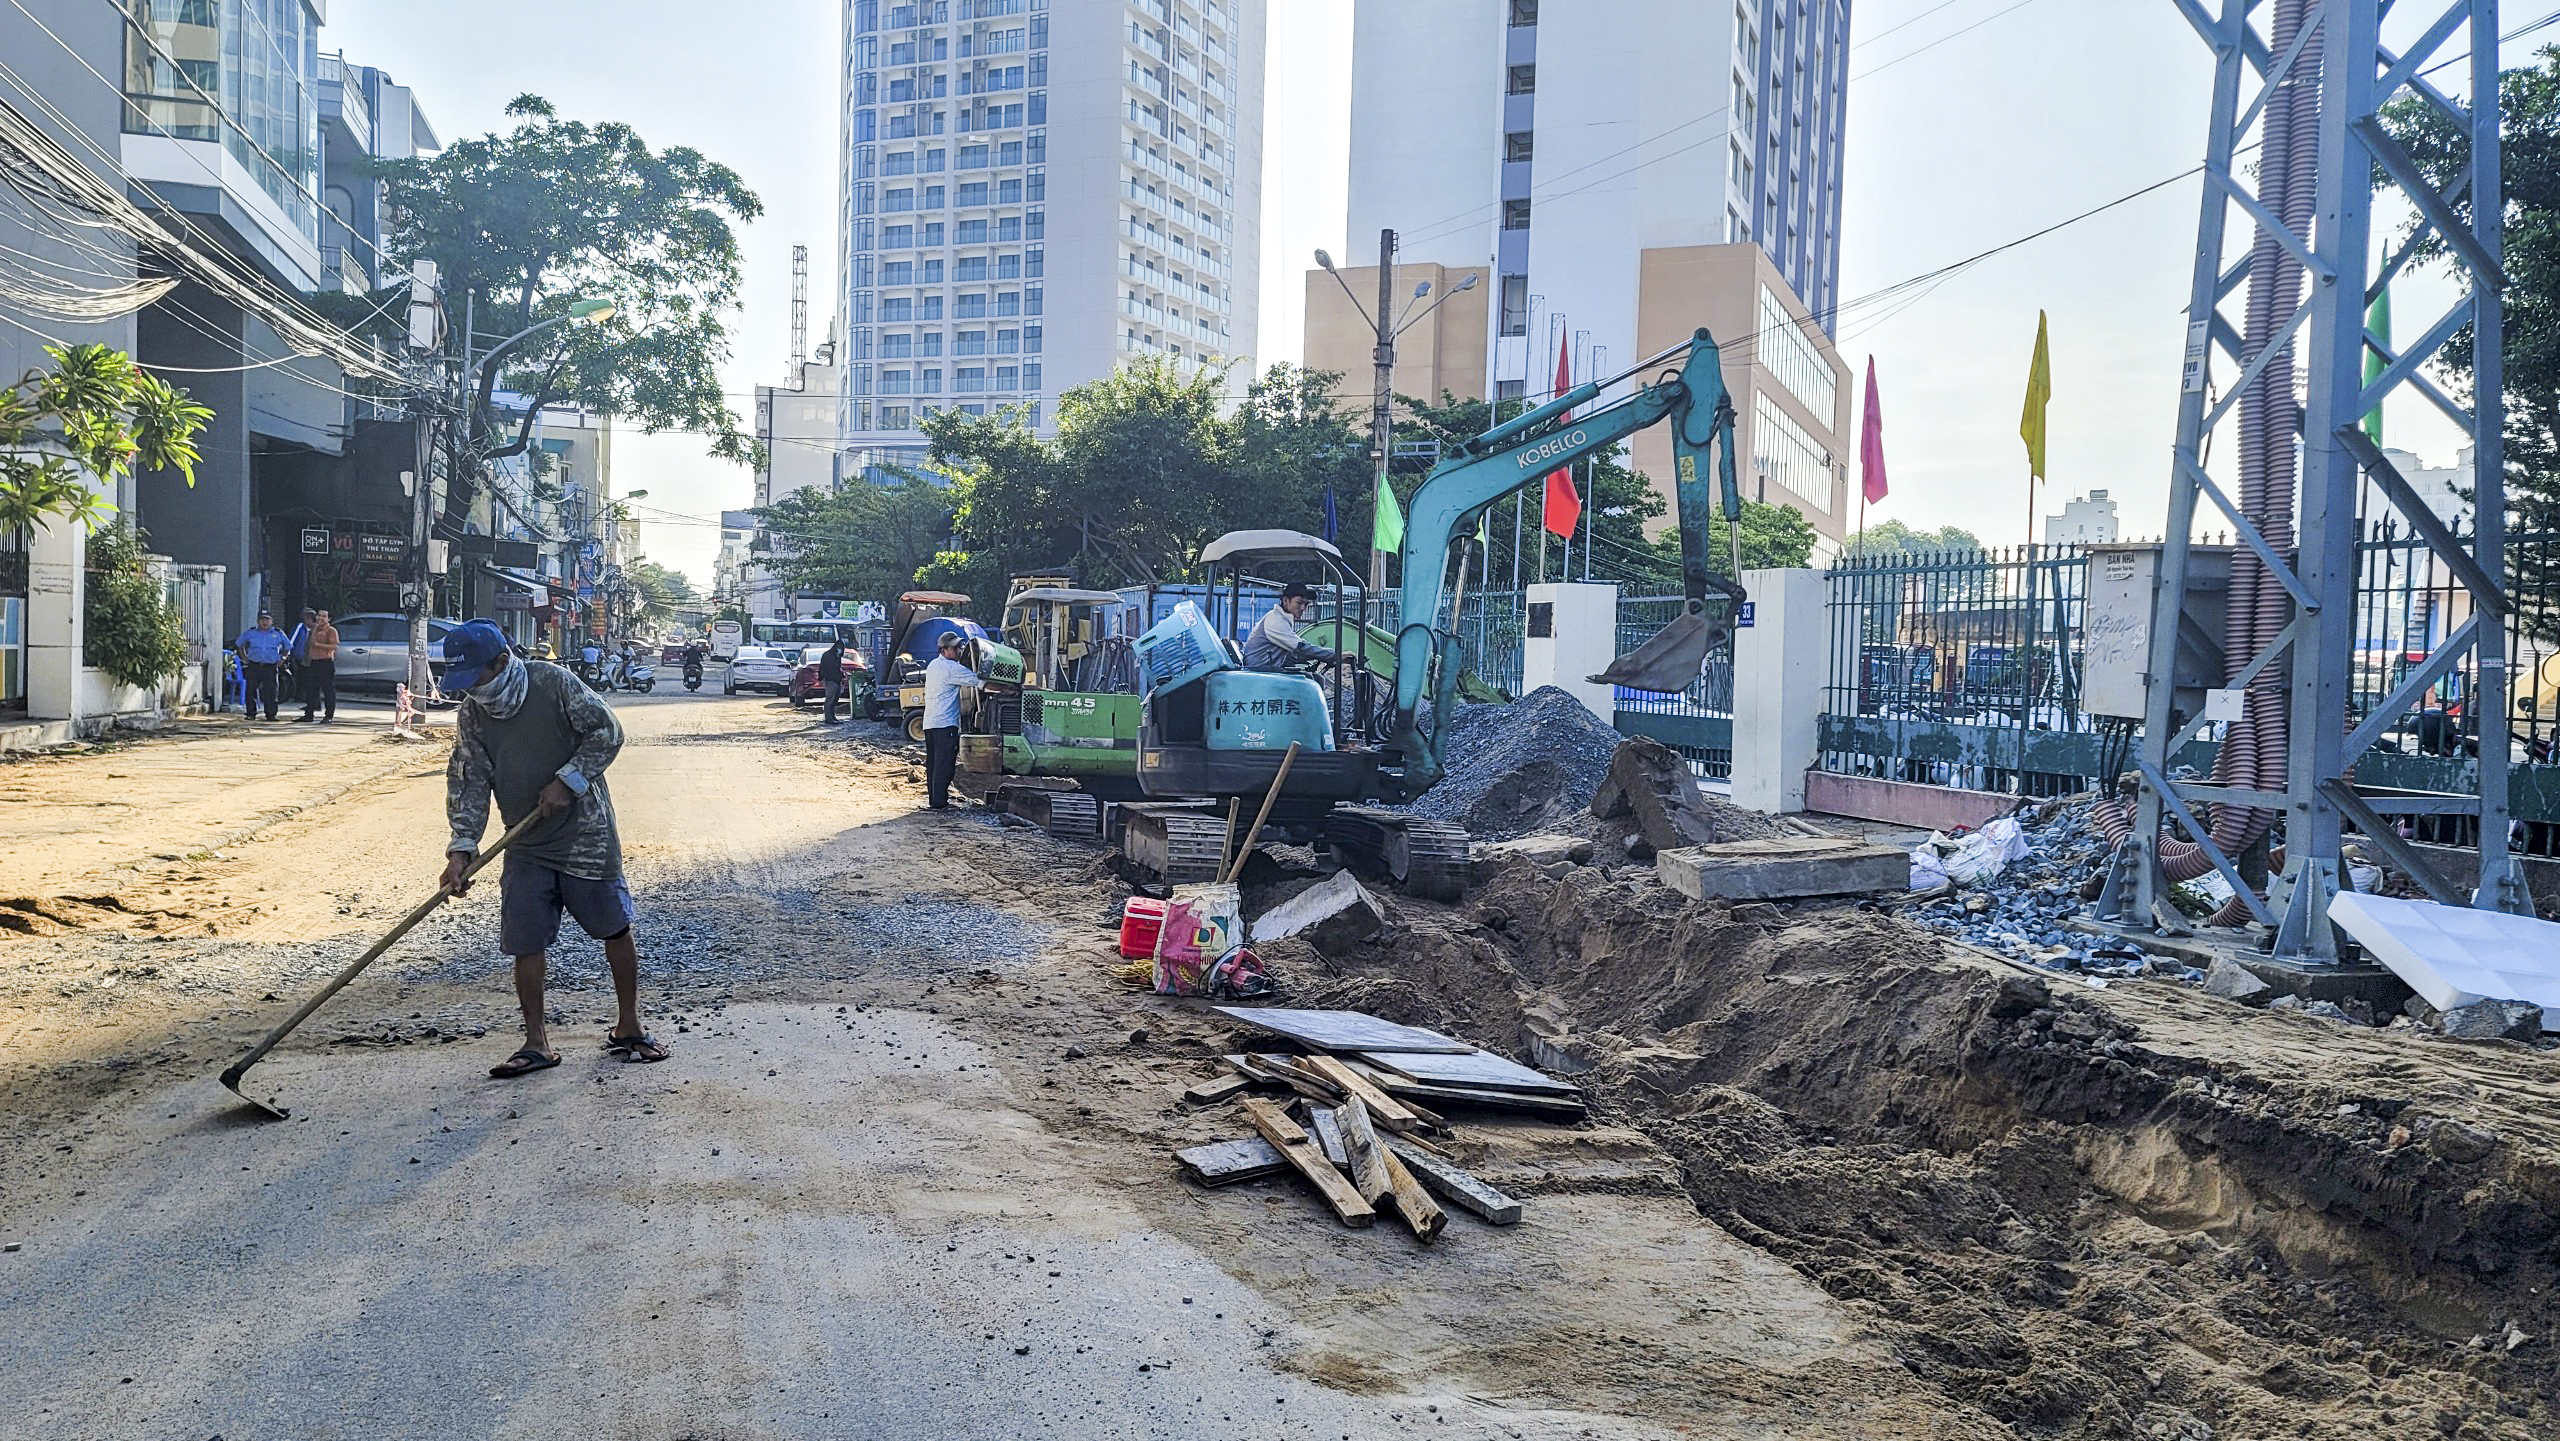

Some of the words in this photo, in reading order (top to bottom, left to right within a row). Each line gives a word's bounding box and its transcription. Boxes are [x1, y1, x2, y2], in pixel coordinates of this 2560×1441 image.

[1516, 430, 1587, 468] KOBELCO
[1743, 605, 1751, 618] 33
[1071, 698, 1095, 707] 45
